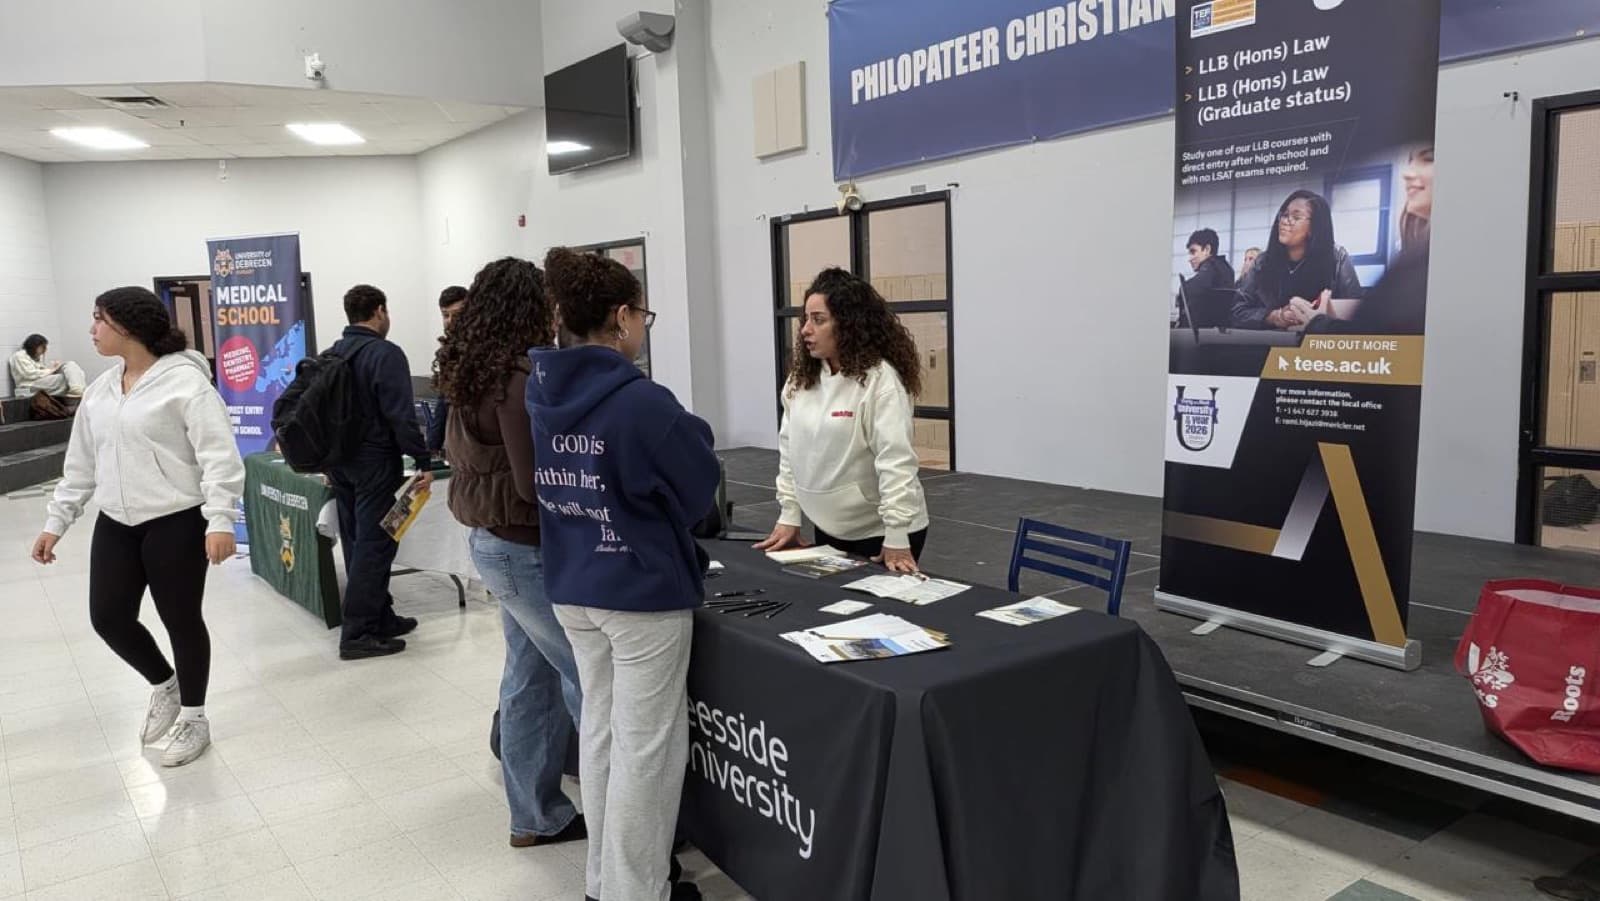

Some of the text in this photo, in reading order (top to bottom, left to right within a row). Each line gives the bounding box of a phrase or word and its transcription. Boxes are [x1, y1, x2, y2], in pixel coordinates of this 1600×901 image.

[851, 26, 1000, 105] PHILOPATEER
[1199, 35, 1330, 75] LLB (Hons) Law
[1198, 65, 1329, 102] LLB (Hons) Law
[1198, 81, 1352, 126] (Graduate status)
[1182, 131, 1332, 162] Study one of our LLB courses with
[1182, 144, 1329, 173] direct entry after high school and
[1182, 161, 1309, 185] with no LSAT exams required.
[216, 284, 288, 305] MEDICAL
[217, 305, 280, 326] SCHOOL
[1309, 339, 1398, 351] FIND OUT MORE
[1294, 356, 1392, 375] tees.ac.uk
[1276, 387, 1352, 399] For more information,
[1276, 396, 1382, 410] please contact the local office
[1185, 424, 1209, 435] 2026
[552, 434, 605, 455] GOD is
[580, 470, 606, 492] her,
[558, 502, 585, 516] will
[585, 506, 612, 522] not
[1550, 665, 1586, 722] Roots
[688, 695, 789, 777] eesside
[691, 741, 816, 860] niversity
